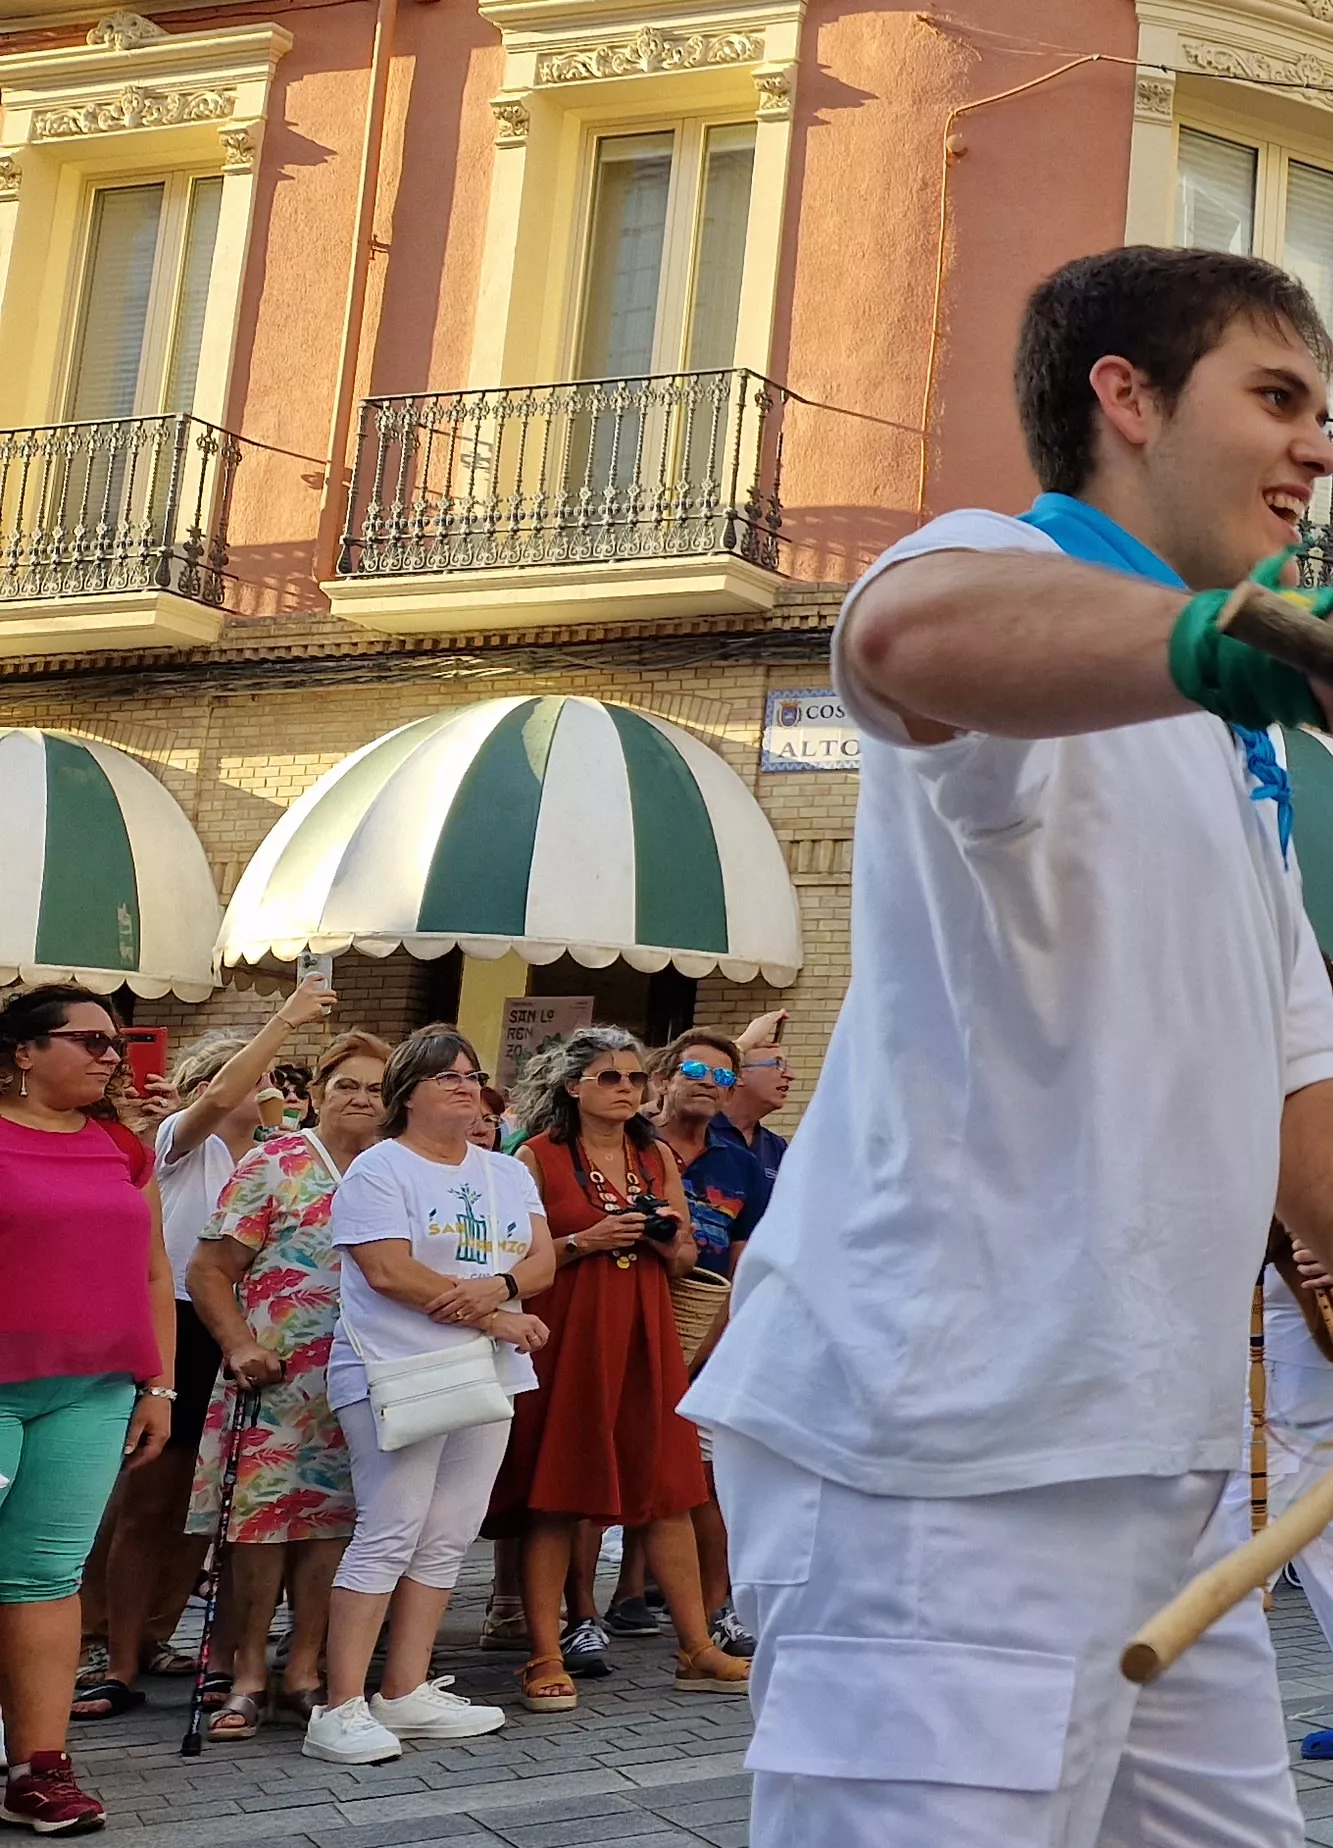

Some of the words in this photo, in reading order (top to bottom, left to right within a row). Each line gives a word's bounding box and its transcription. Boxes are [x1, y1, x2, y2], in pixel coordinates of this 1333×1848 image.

[806, 704, 846, 720] COS
[778, 740, 860, 759] ALTO
[509, 1009, 536, 1023] SAN
[506, 1027, 533, 1040] REN
[428, 1223, 465, 1236] SAN
